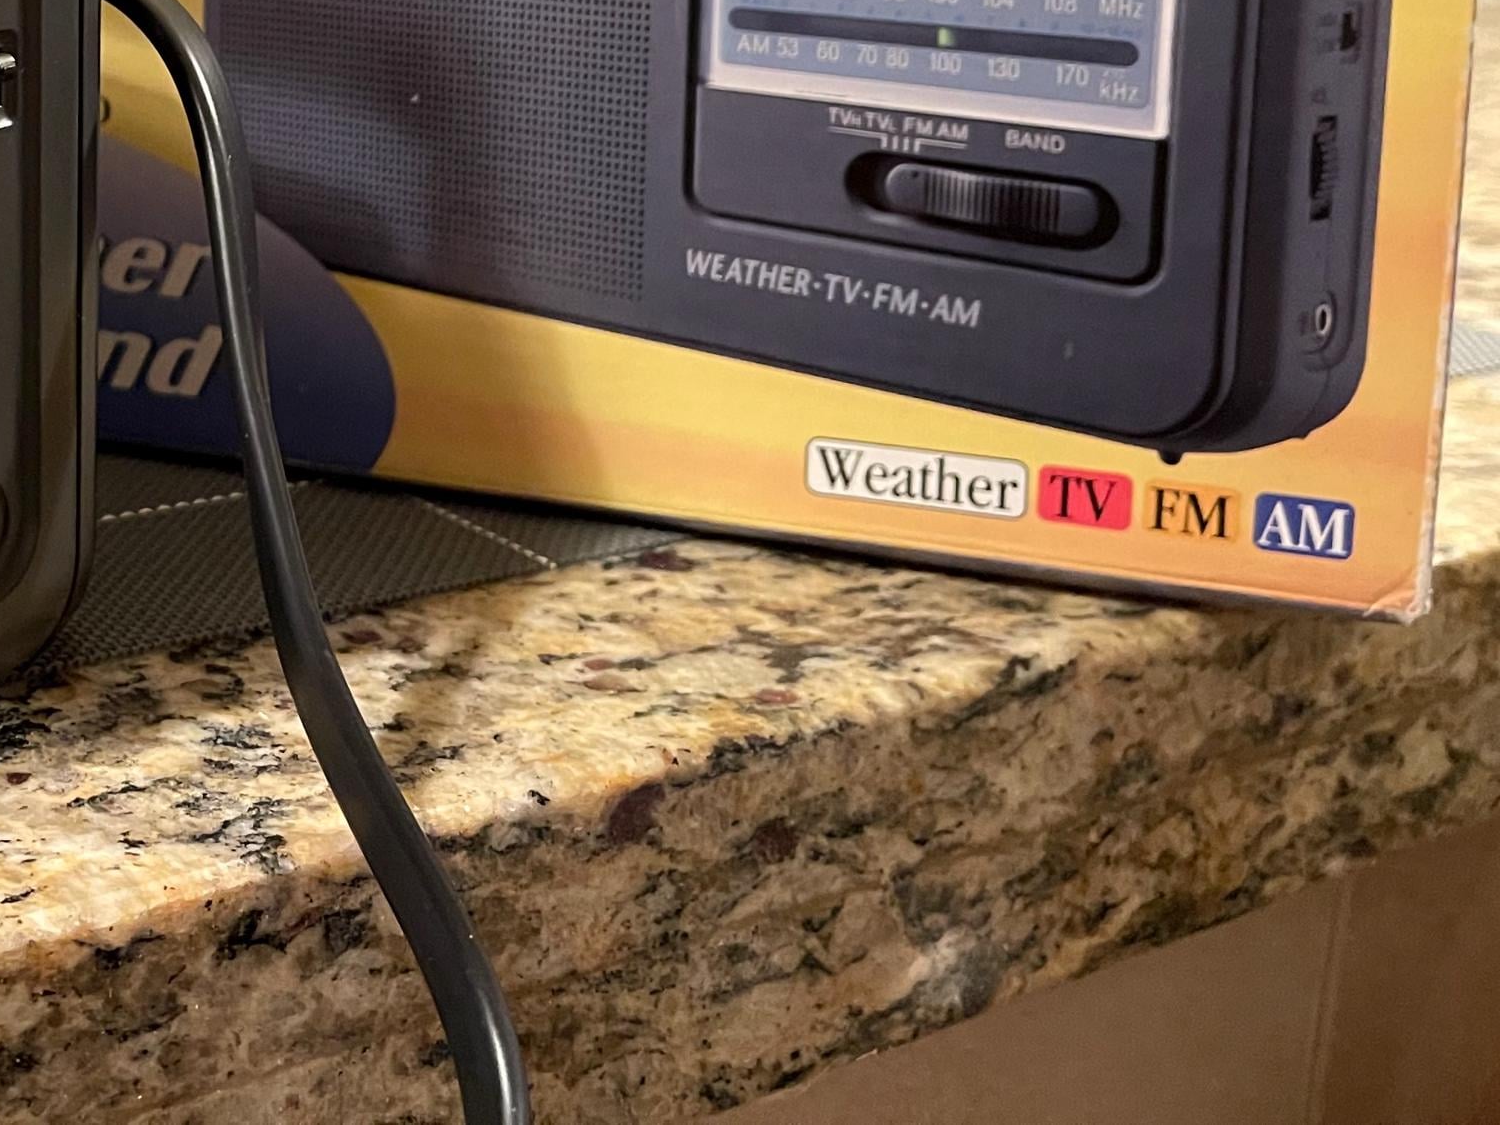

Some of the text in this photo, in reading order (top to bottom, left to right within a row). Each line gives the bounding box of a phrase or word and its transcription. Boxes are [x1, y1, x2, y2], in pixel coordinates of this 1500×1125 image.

[736, 34, 770, 55] AM
[778, 36, 799, 58] 53
[817, 40, 840, 62] 60
[857, 44, 878, 65] 70
[886, 47, 909, 69] 80
[931, 51, 962, 74] 100
[988, 57, 1020, 81] 130
[1056, 63, 1089, 87] 170
[1100, 82, 1139, 102] kHz
[903, 115, 933, 136] FM
[936, 121, 969, 141] AM
[1004, 128, 1066, 154] BAND
[100, 236, 212, 298] er
[815, 445, 1352, 557] Weather TV FM AM
